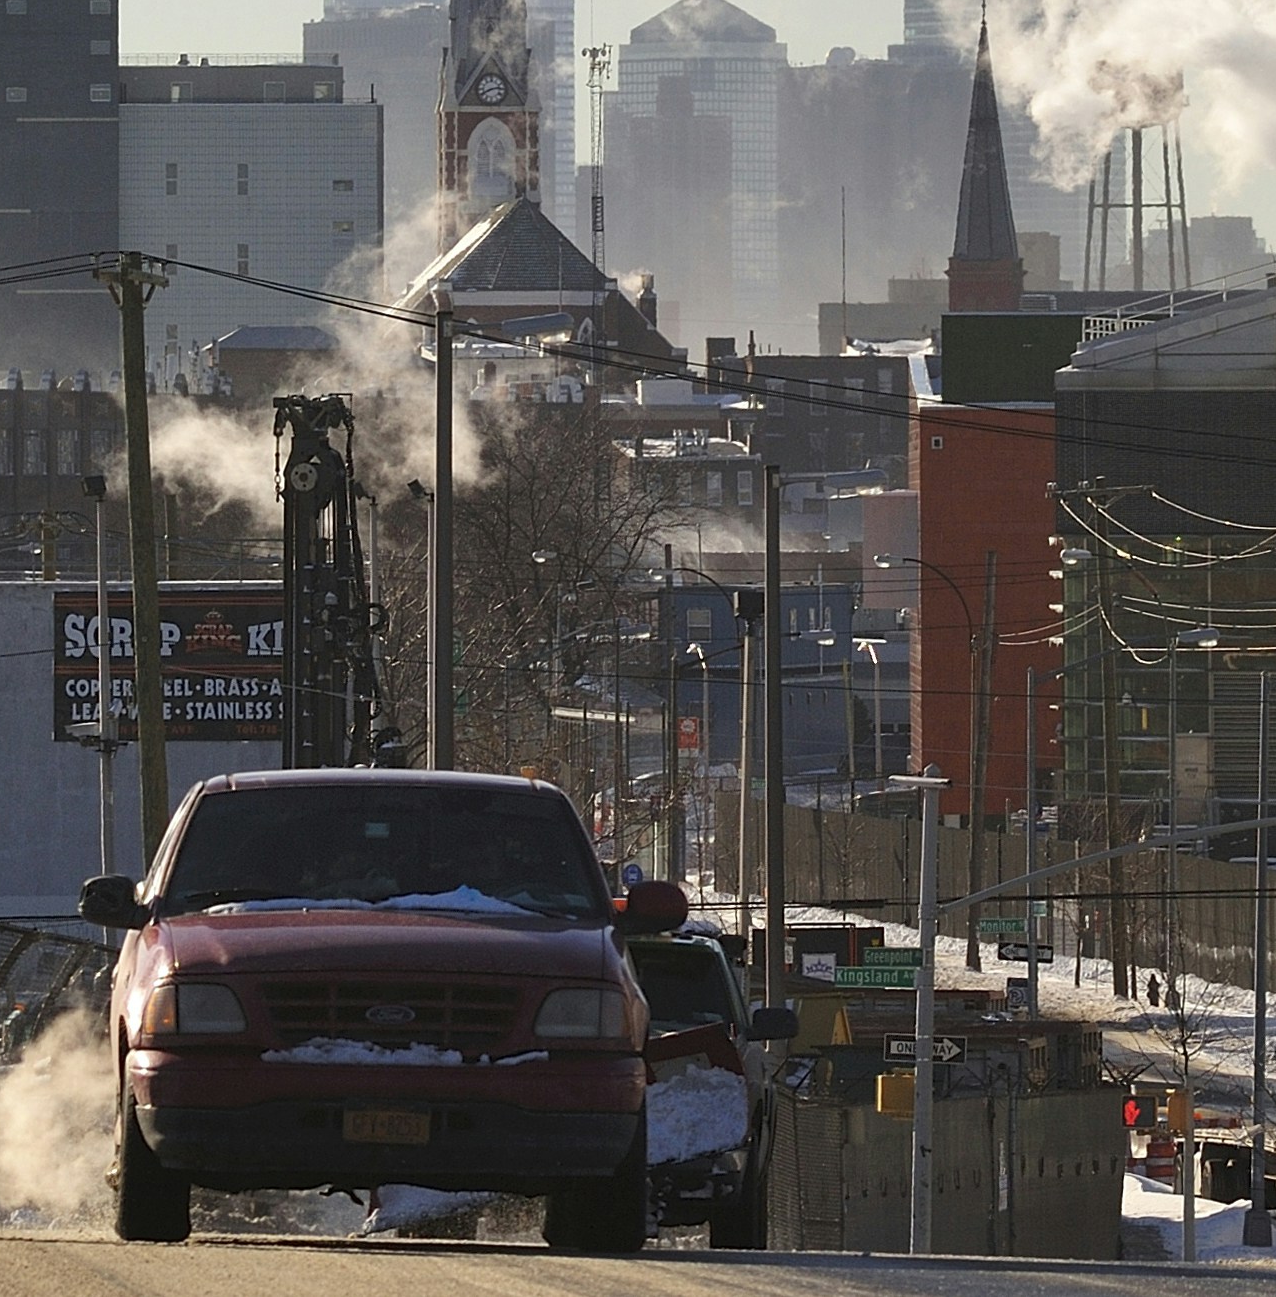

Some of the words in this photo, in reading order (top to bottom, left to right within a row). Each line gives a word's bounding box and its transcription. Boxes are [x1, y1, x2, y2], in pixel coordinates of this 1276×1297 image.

[64, 613, 181, 658] SCRP
[65, 679, 134, 697] COPER
[159, 678, 193, 697] EEL
[204, 678, 259, 696] BRASS
[185, 702, 273, 720] STAINLESS
[980, 920, 1017, 931] Monitor
[864, 949, 913, 966] Greenpoint
[836, 969, 899, 986] Kingsland
[896, 1042, 916, 1053] ON
